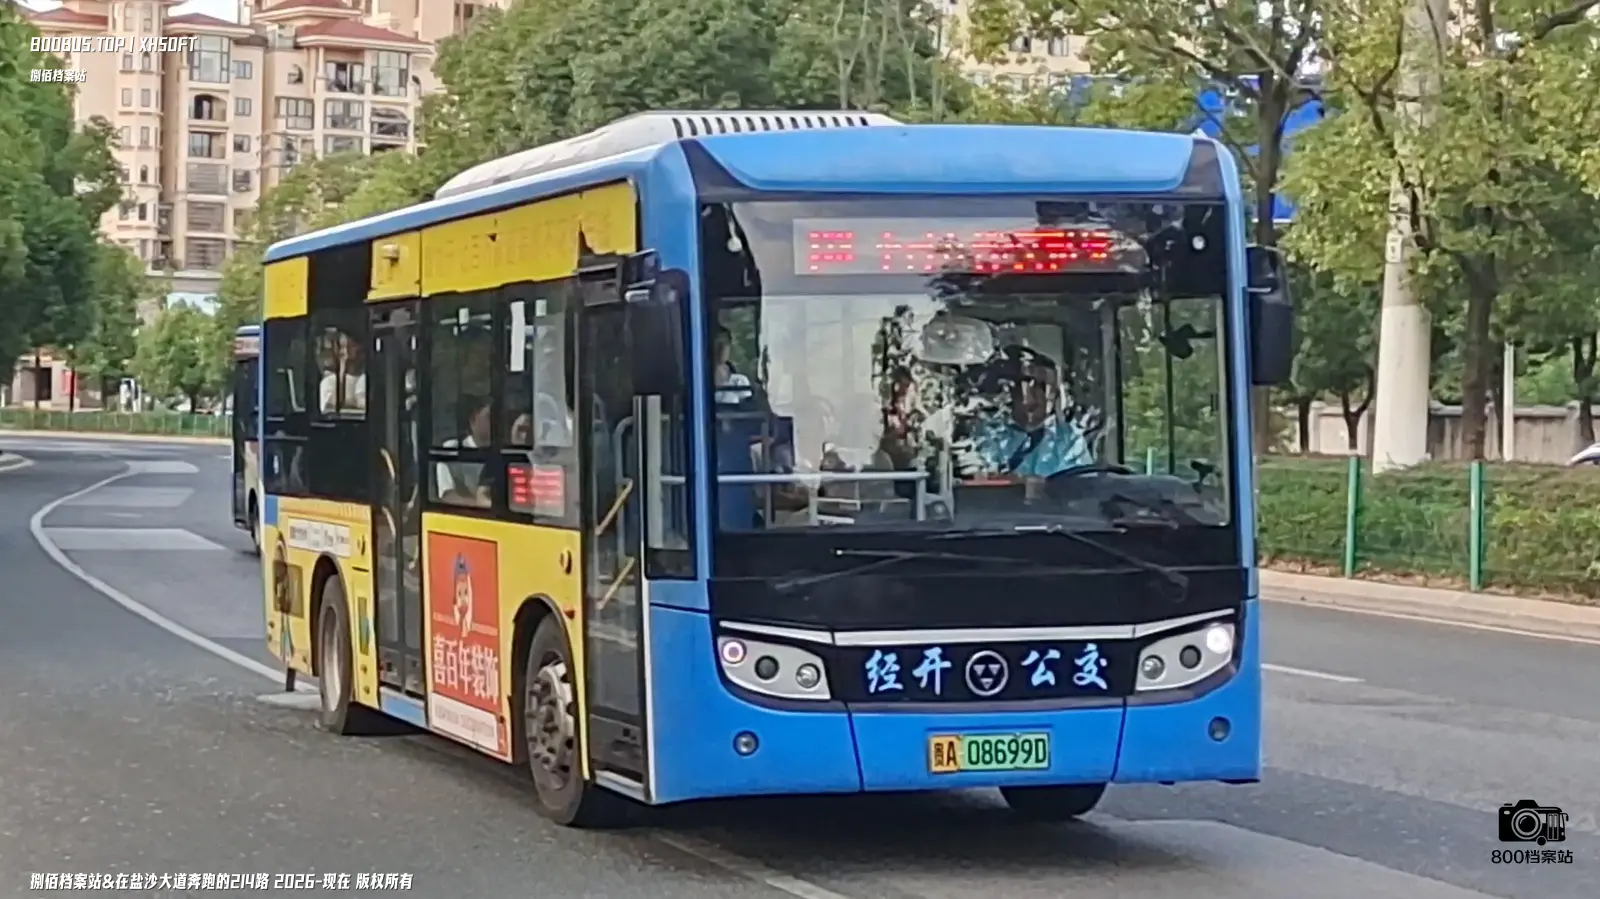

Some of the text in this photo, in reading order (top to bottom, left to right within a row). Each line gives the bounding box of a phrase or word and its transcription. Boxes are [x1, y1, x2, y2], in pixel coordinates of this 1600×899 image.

[865, 643, 1108, 695] 经开 公交
[968, 738, 1047, 766] 08699D
